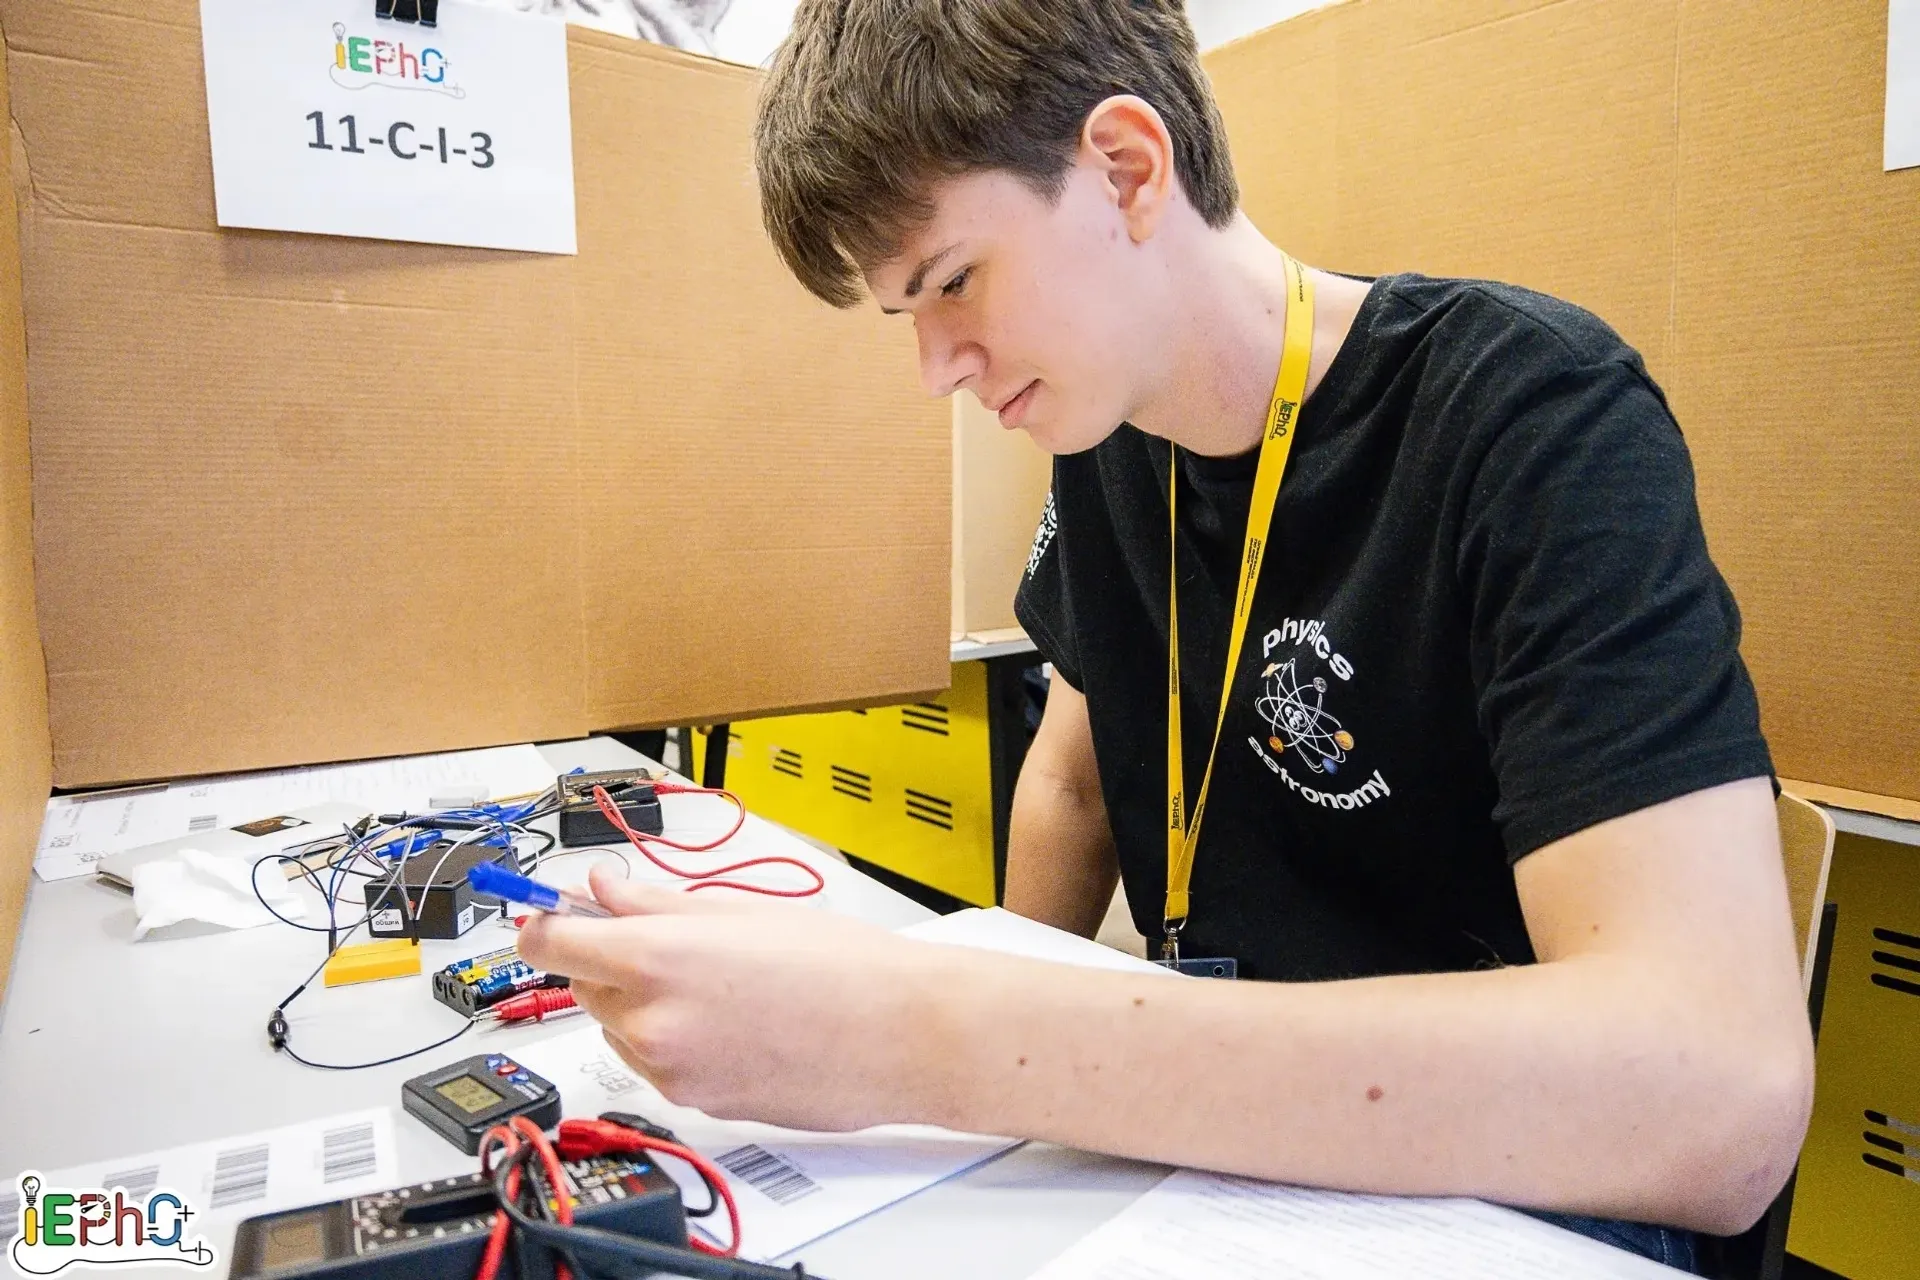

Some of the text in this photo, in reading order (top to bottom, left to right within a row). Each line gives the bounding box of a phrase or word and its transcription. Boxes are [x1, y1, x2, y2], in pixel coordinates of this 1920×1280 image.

[306, 110, 495, 169] 11-C-I-3
[1263, 617, 1354, 681] physics
[1248, 736, 1391, 810] astronomy
